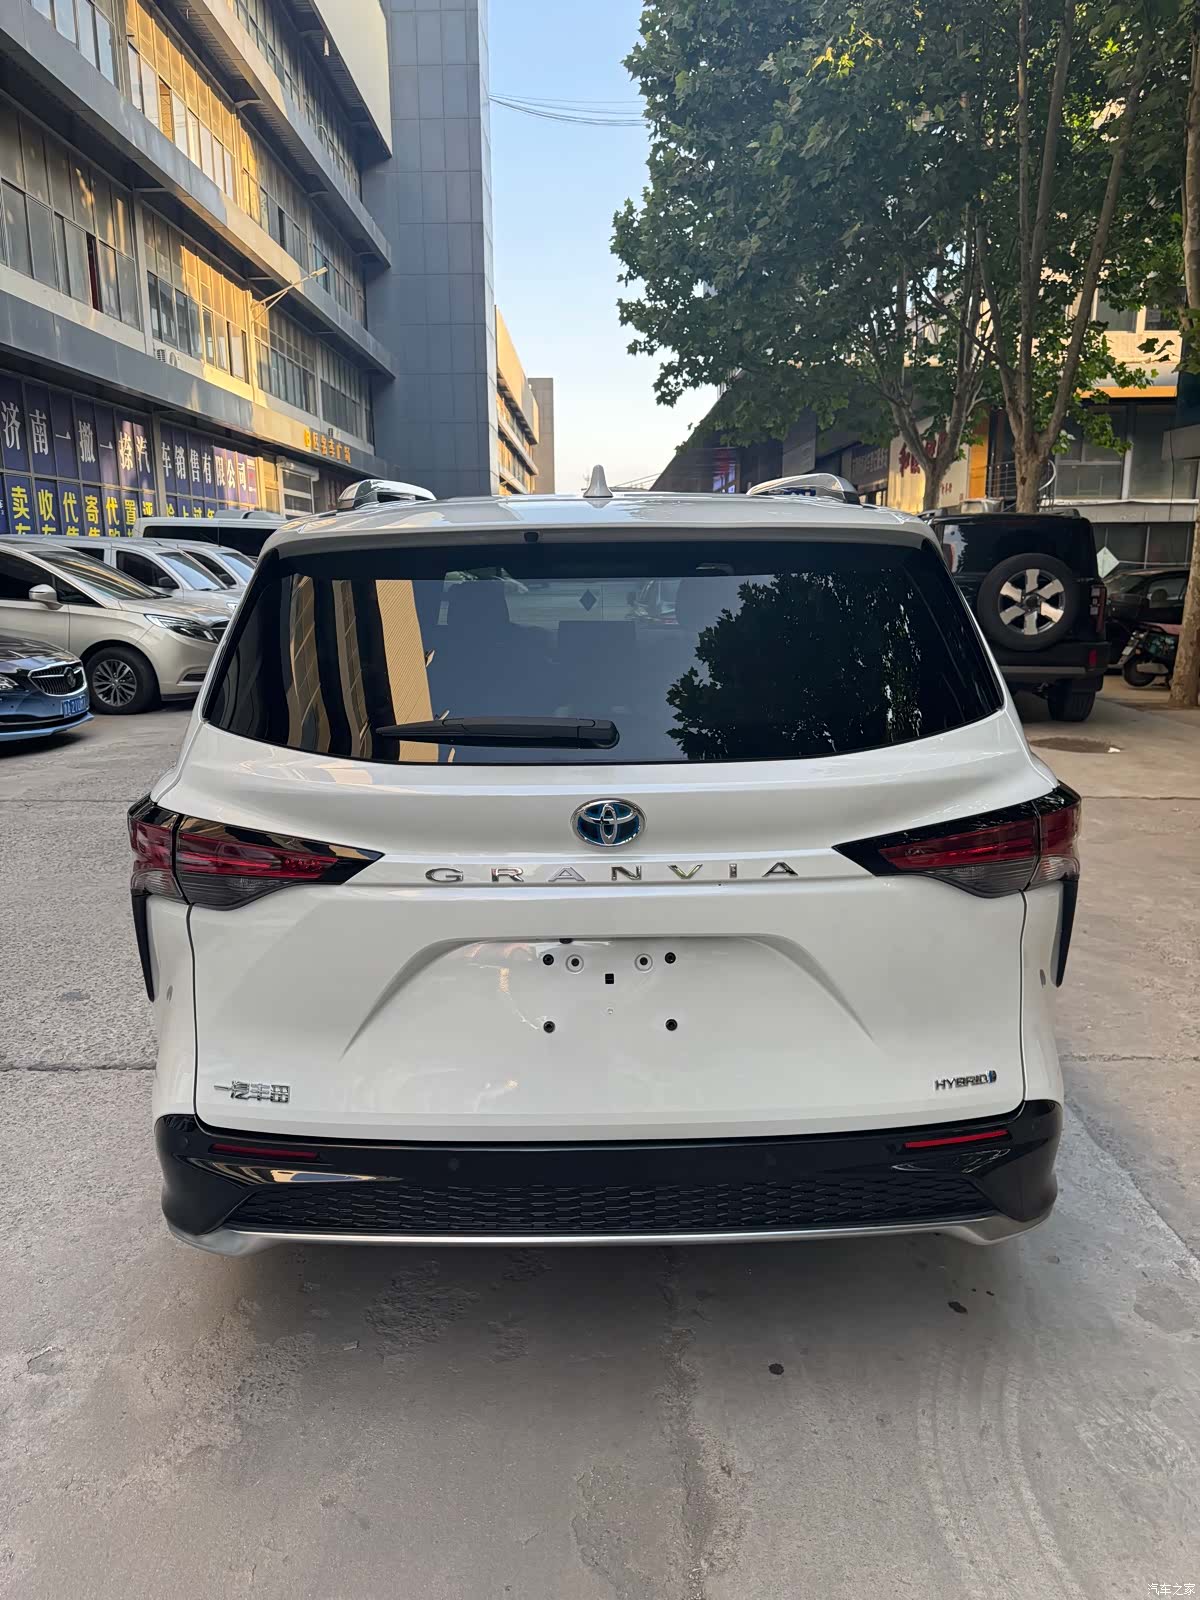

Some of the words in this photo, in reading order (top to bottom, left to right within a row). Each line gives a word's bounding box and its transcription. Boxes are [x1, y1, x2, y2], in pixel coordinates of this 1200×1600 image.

[424, 861, 799, 882] GRANVIA
[213, 1080, 290, 1103] 一汽丰田
[934, 1073, 988, 1091] HYBRID
